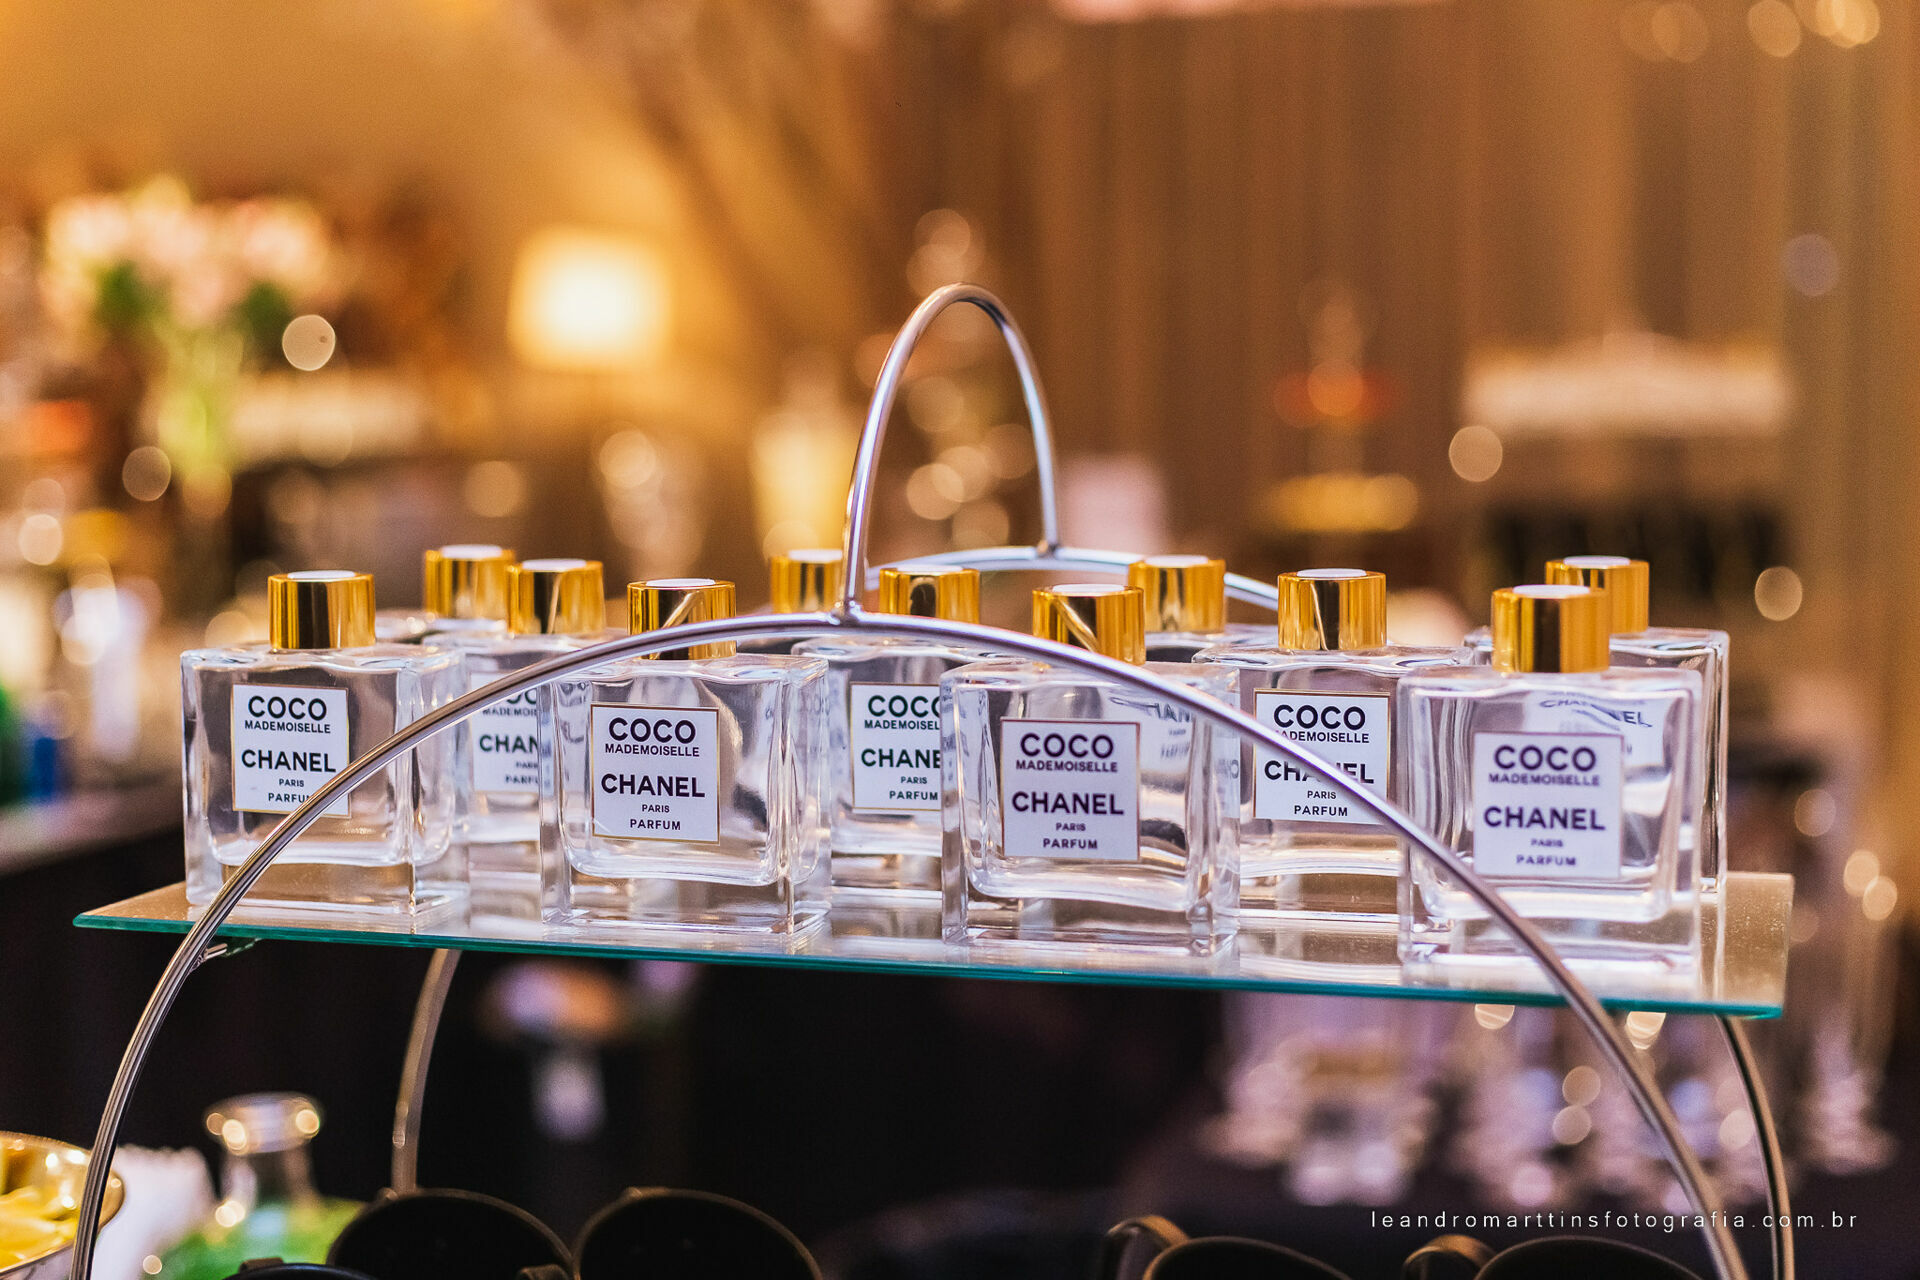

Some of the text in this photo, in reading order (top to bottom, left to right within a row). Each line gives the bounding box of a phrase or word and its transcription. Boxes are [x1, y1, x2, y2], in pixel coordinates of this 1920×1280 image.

[248, 696, 327, 721] COCO
[864, 719, 940, 730] MADEMOISEL
[1273, 704, 1366, 731] COCO
[244, 720, 331, 734] MADEMOISELLE
[608, 717, 696, 744] COCO
[479, 734, 538, 753] CHAN
[1275, 730, 1370, 743] ADEMOISELLE
[605, 743, 700, 757] MADEMOISELLE
[1020, 732, 1114, 759] COCO
[241, 749, 336, 773] CHANEL
[861, 748, 940, 769] CHANE
[1494, 745, 1597, 772] COCO
[1015, 759, 1118, 773] MADEMOISELLE
[1264, 760, 1375, 784] CHEL
[279, 778, 304, 787] PARIS
[601, 773, 705, 798] CHANEL
[900, 776, 928, 785] PARIS
[1488, 773, 1600, 787] MADEMOISELLE
[268, 792, 310, 803] PARFU
[889, 790, 938, 801] PARFUM
[1307, 790, 1337, 799] PARIS
[641, 804, 670, 813] PARIS
[1012, 790, 1124, 815] CHANEL
[1294, 805, 1348, 816] PARFUM
[630, 818, 681, 830] PARFUM
[1483, 805, 1606, 831] CHANEL
[1055, 822, 1086, 832] PARIS
[1042, 838, 1098, 849] PARFUM
[1530, 839, 1564, 848] PARIS
[1515, 854, 1577, 866] PARFUM
